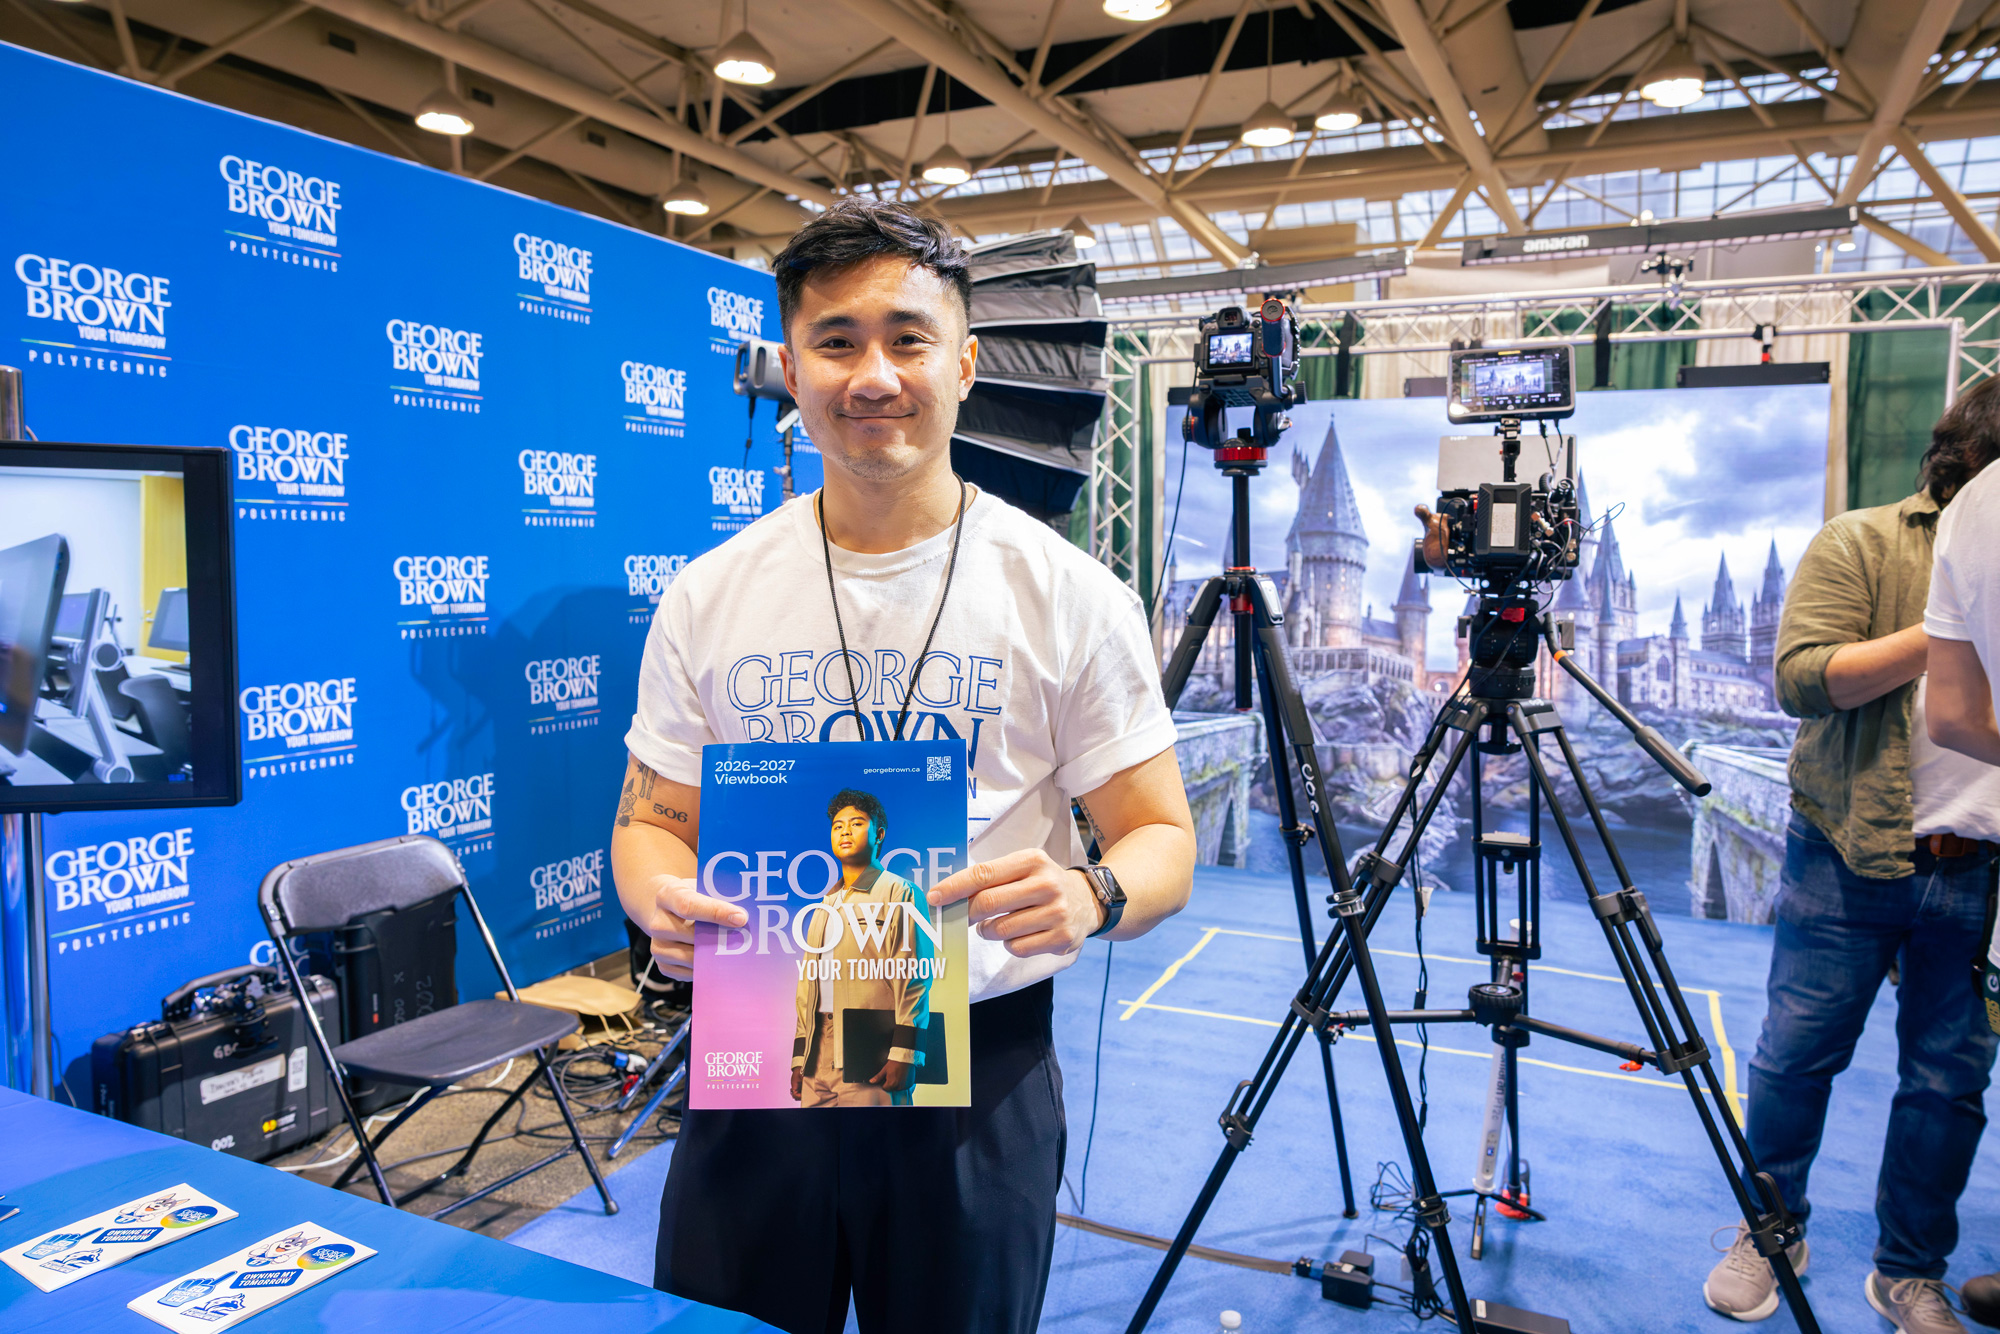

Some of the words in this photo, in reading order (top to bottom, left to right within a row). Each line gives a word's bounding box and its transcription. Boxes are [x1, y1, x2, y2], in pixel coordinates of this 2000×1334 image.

[220, 155, 342, 210] GEORGE
[228, 183, 336, 234] BROWN
[230, 240, 338, 272] POLYTECHNIC
[514, 233, 594, 274] GEORGE
[1523, 235, 1589, 252] amaran
[15, 254, 172, 307] GEORGE
[519, 256, 590, 293] BROWN
[26, 285, 165, 335] BROWN
[707, 287, 764, 320] GEORGE
[711, 306, 761, 336] BROWN
[78, 325, 107, 341] YOUR
[108, 329, 166, 349] TOMORROW
[386, 319, 484, 357] GEORGE
[29, 350, 167, 378] POLYTECHNIC
[393, 344, 479, 380] BROWN
[621, 360, 687, 391] GEORGE
[625, 382, 684, 409] BROWN
[229, 425, 349, 459] GEORGE
[237, 453, 344, 484] BROWN
[518, 449, 597, 477] GEORGE
[524, 472, 593, 496] BROWN
[239, 508, 345, 522] POLYTECHNIC
[393, 556, 490, 580] GEORGE
[400, 579, 485, 605] BROWN
[525, 655, 601, 683] GEORGE
[727, 650, 1002, 714] GEORGE
[239, 678, 358, 714] GEORGE
[531, 676, 597, 704] BROWN
[247, 703, 352, 741] BROWN
[249, 753, 354, 779] POLYTECHNIC
[714, 772, 788, 784] Viewbook
[863, 766, 920, 774] georgebrown.ca
[401, 773, 495, 811] GEORGE
[408, 796, 490, 835] BROWN
[653, 803, 688, 822] 506
[45, 828, 195, 881] GEORGE
[530, 848, 604, 889] GEORGE
[55, 856, 188, 912] BROWN
[536, 869, 601, 910] BROWN
[703, 847, 957, 903] GEOGE
[105, 897, 133, 915] YOUR
[134, 884, 189, 908] TOMORROW
[59, 912, 190, 955] POLYTECHNIC
[796, 959, 841, 981] YOUR
[847, 958, 947, 980] TOMORROW
[705, 1052, 764, 1064] GEORGE
[708, 1064, 759, 1077] BROWN
[238, 1278, 291, 1286] TOMORROW
[243, 1272, 281, 1280] OWNING
